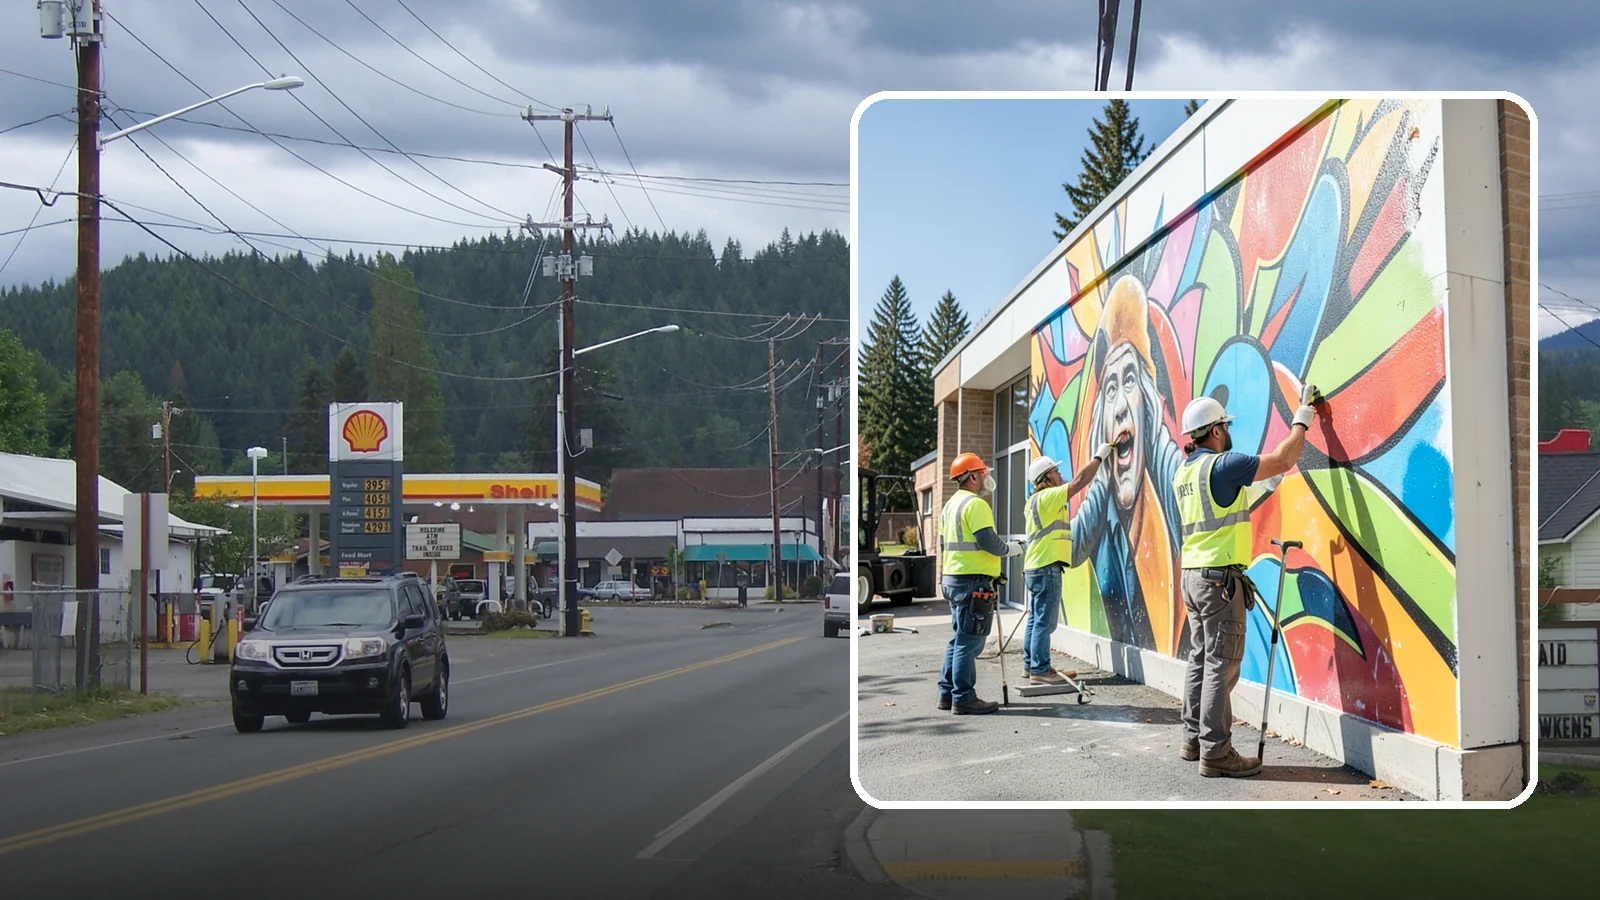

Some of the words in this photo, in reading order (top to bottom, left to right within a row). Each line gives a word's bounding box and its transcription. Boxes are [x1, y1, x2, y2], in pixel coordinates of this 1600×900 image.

[366, 480, 383, 490] 395
[490, 484, 547, 499] Shell
[366, 494, 383, 504] 405
[366, 508, 383, 518] 415
[366, 522, 383, 533] 429
